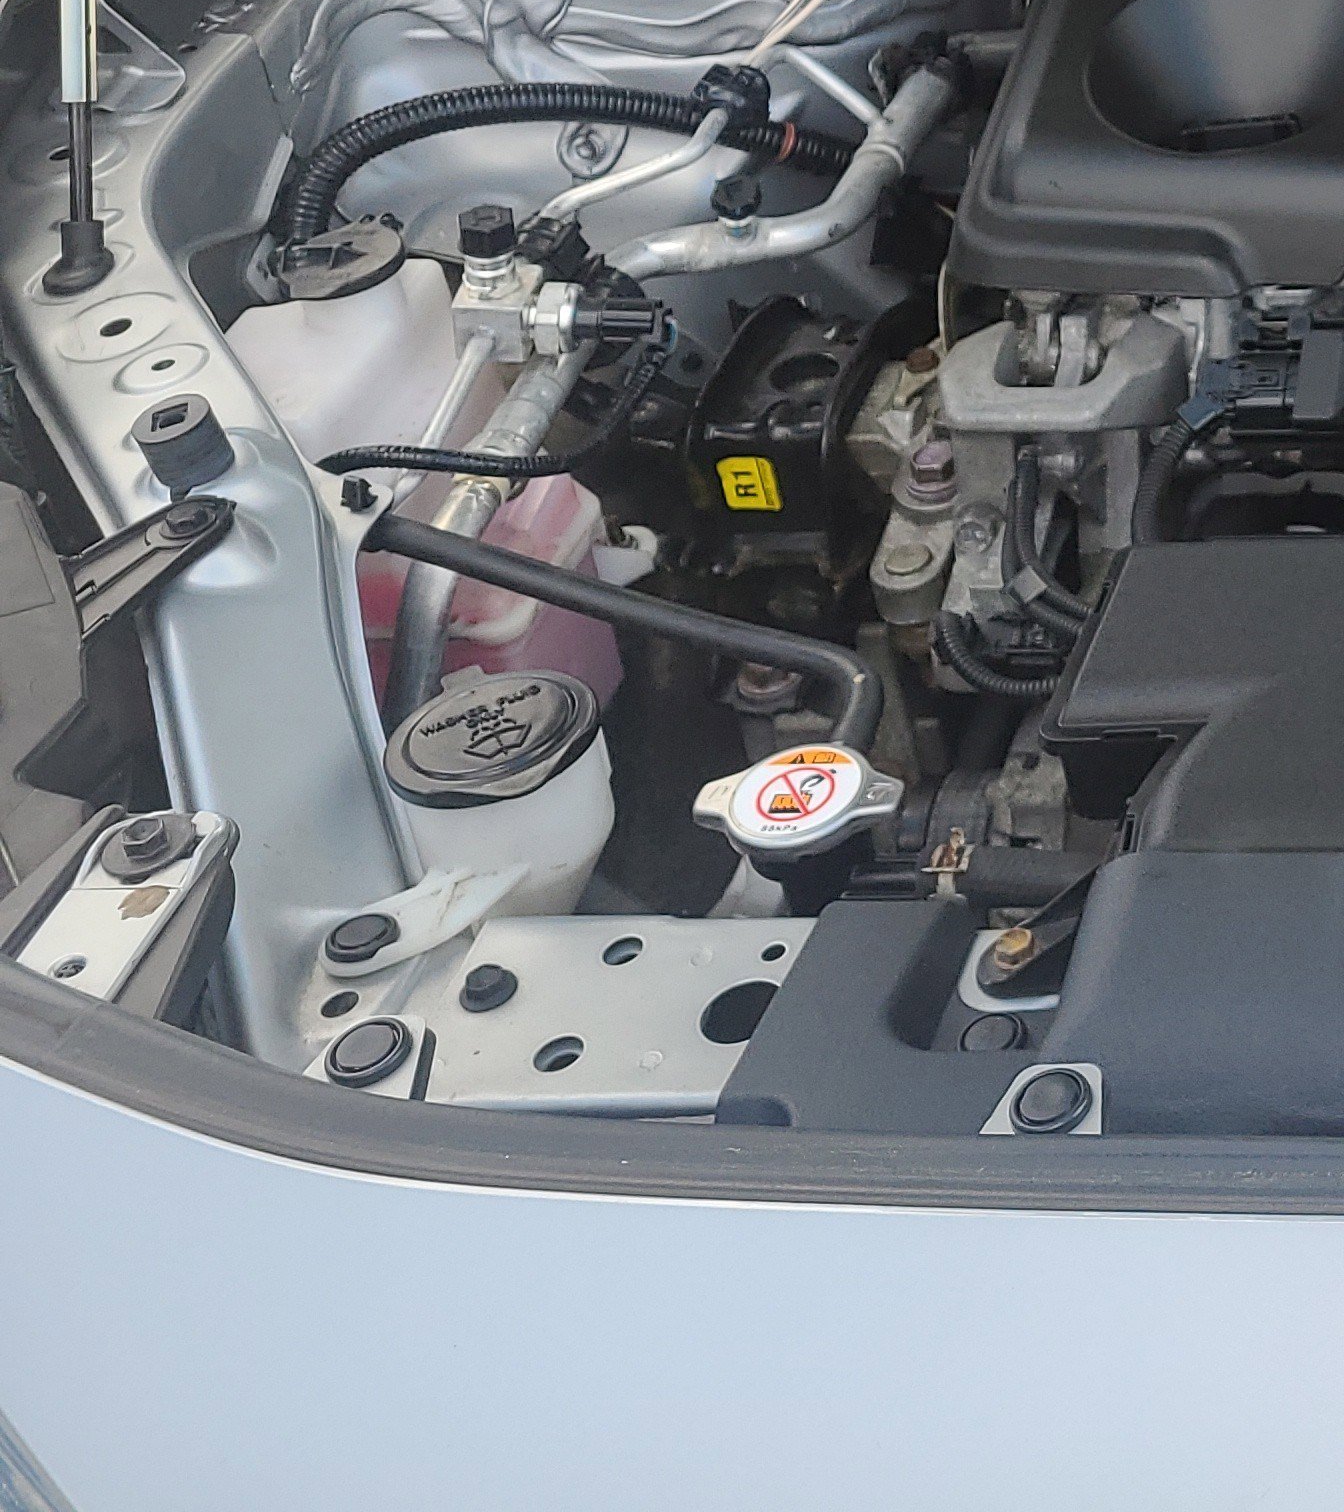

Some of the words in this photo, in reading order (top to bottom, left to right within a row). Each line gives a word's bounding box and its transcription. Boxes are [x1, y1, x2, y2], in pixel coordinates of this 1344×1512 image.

[731, 471, 758, 497] R1
[420, 705, 488, 737] WASHER
[496, 685, 541, 706] FLUID
[466, 707, 505, 729] ONLY
